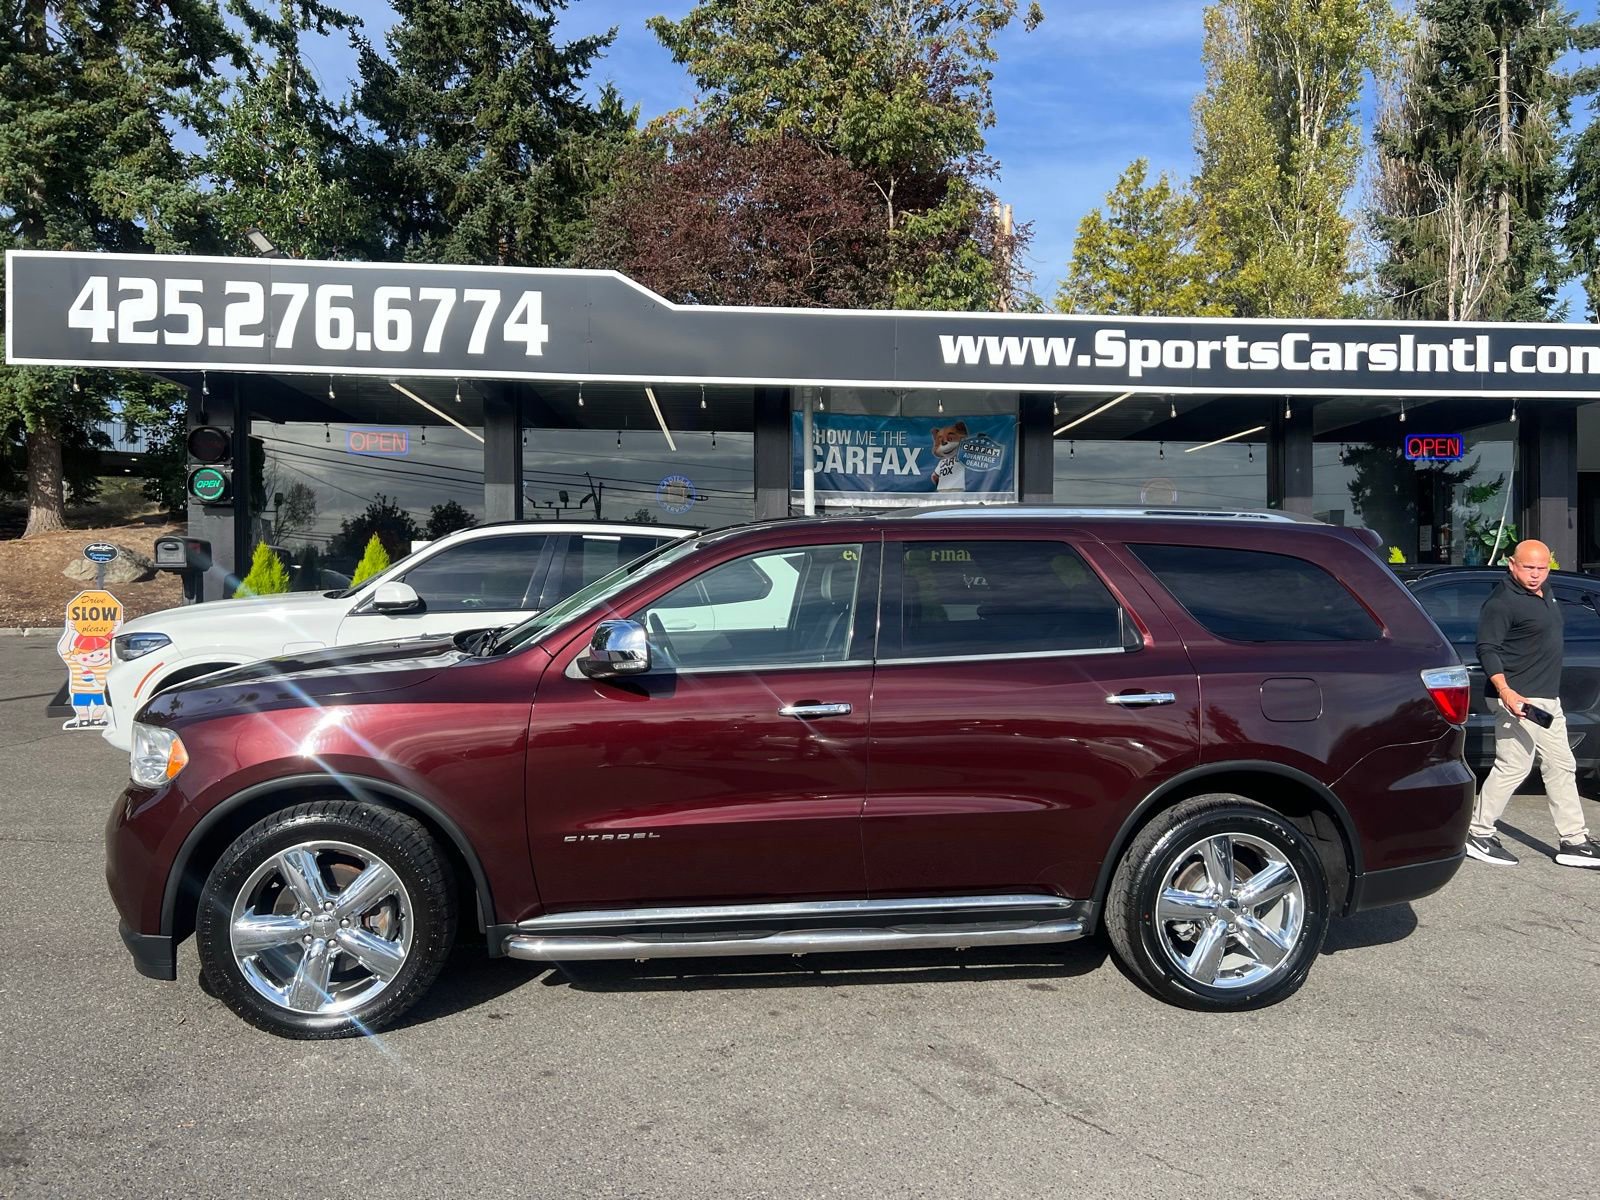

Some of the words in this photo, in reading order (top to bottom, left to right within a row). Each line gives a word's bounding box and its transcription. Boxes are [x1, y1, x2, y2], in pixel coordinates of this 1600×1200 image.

[68, 275, 550, 357] 425.276.6774
[350, 431, 406, 452] OPEN
[812, 429, 851, 445] HOW
[856, 430, 877, 446] ME
[881, 430, 908, 446] THE
[963, 443, 1001, 457] CARFAX
[1408, 437, 1459, 457] OPEN
[962, 452, 996, 464] ADVANTAGE
[965, 460, 989, 469] DEALER
[940, 466, 954, 477] FOX
[196, 480, 221, 489] OPEN
[80, 595, 106, 604] Drive
[71, 606, 118, 621] SLOW
[81, 624, 109, 633] please
